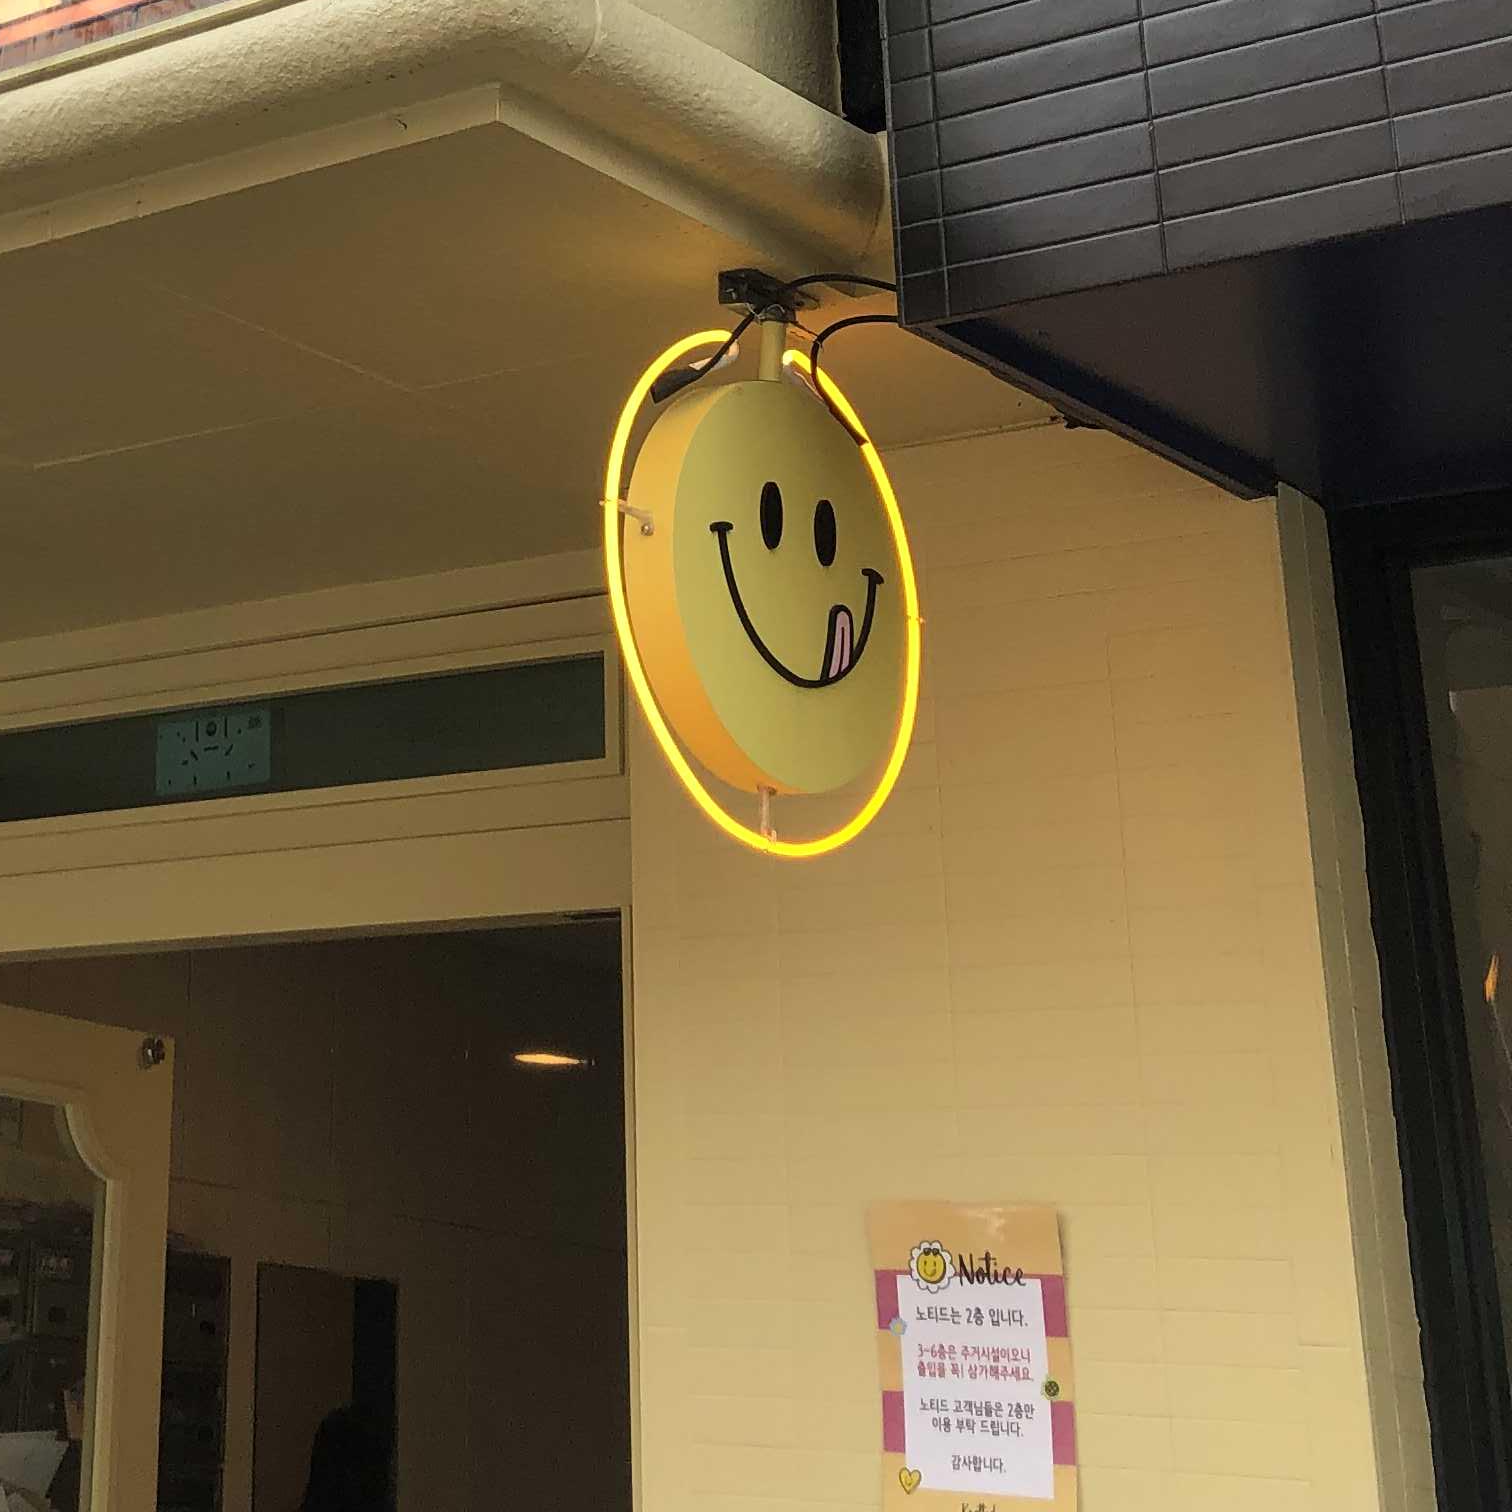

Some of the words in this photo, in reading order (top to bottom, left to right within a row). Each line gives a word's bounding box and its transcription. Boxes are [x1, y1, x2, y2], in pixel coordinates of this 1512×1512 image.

[958, 1251, 1026, 1287] Notice
[915, 1305, 962, 1325] 노티드는
[965, 1306, 985, 1326] 2층
[988, 1308, 1029, 1328] 입니다.
[961, 1344, 1031, 1364] 주거시설이오니
[919, 1398, 950, 1414] 노티드
[953, 1400, 1004, 1418] 고객님들은
[1007, 1402, 1035, 1420] 2층만
[931, 1417, 952, 1433] 이용
[955, 1418, 977, 1434] 부탁
[979, 1420, 1025, 1437] 드립니다.
[951, 1454, 1008, 1474] 감사합니다.
